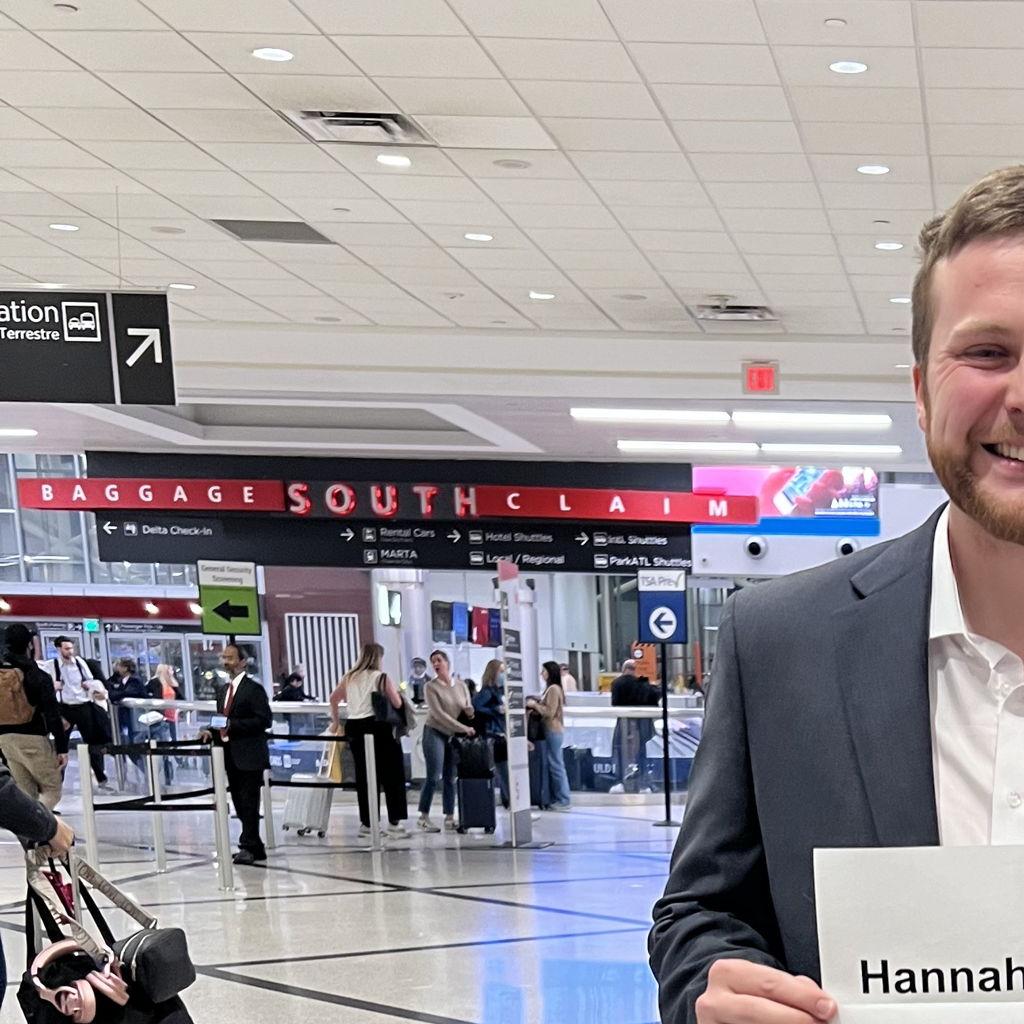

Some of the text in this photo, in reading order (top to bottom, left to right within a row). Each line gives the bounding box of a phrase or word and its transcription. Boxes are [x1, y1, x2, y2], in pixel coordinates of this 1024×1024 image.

[0, 299, 59, 323] ation
[0, 327, 60, 341] Terrestre
[41, 484, 255, 503] BAGGAGE
[287, 481, 477, 518] SOUTH
[507, 492, 728, 517] CLAIM
[142, 524, 168, 535] Delta
[380, 527, 436, 538] Rental Cars
[485, 532, 553, 543] Hotel Shuttles
[627, 535, 668, 545] Shuttles
[380, 549, 418, 559] MARTA
[522, 554, 565, 565] Regional
[609, 556, 691, 568] ParkATL Shuttles
